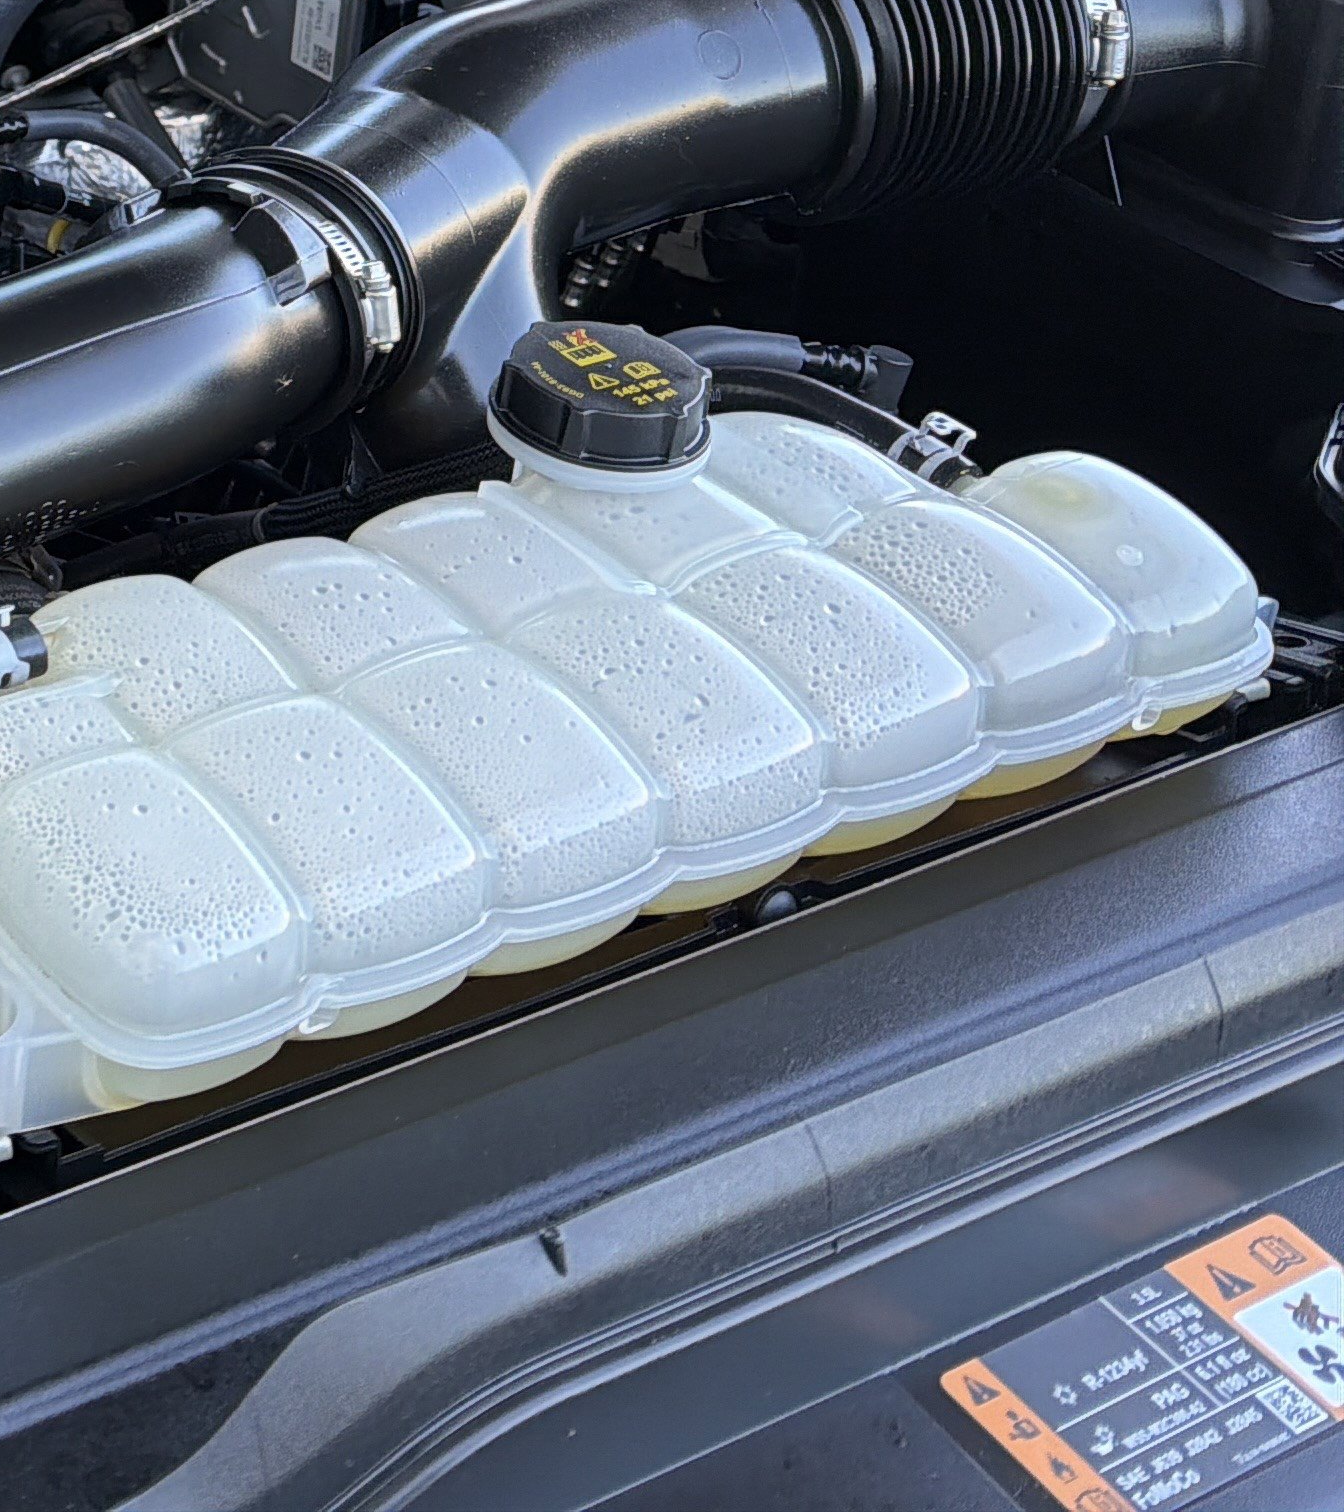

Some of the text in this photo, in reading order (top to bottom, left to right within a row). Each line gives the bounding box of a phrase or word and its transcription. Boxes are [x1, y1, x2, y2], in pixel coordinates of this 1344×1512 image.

[613, 384, 641, 398] 145
[632, 393, 654, 406] 21
[1150, 1382, 1191, 1410] PAG
